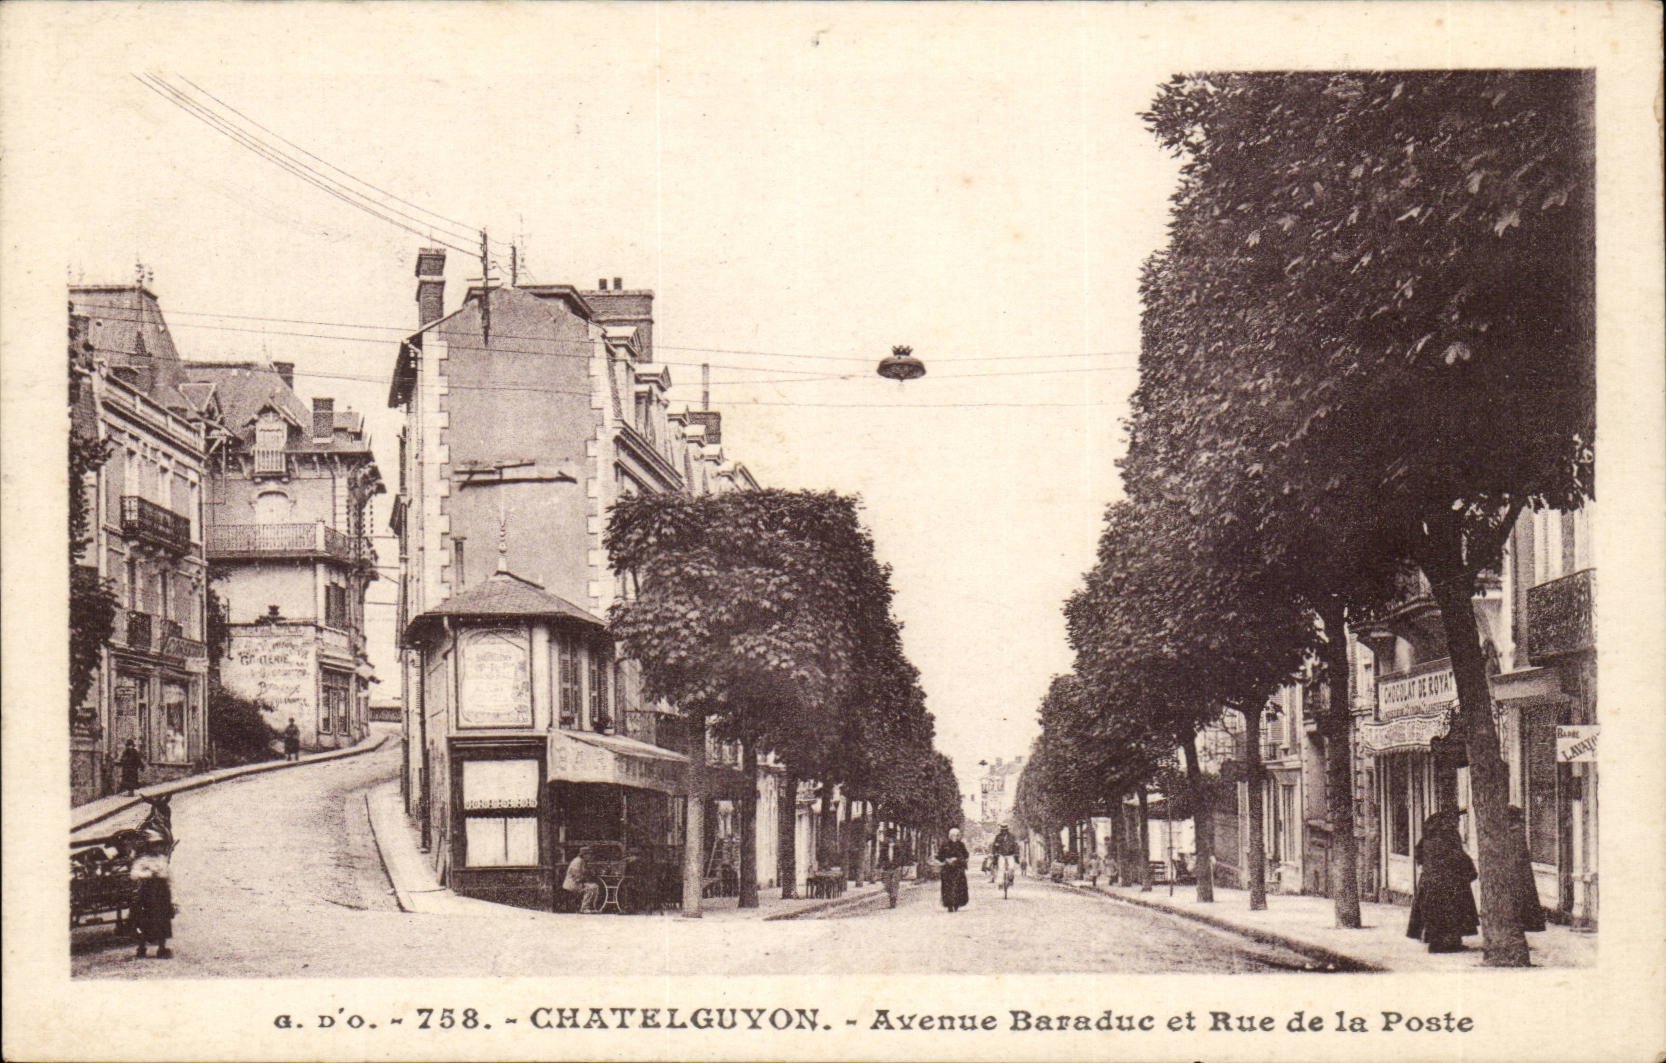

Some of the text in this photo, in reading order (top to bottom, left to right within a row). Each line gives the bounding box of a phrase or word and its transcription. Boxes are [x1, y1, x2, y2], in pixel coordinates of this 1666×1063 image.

[1384, 671, 1453, 705] CHOCOLAT DE ROYAT
